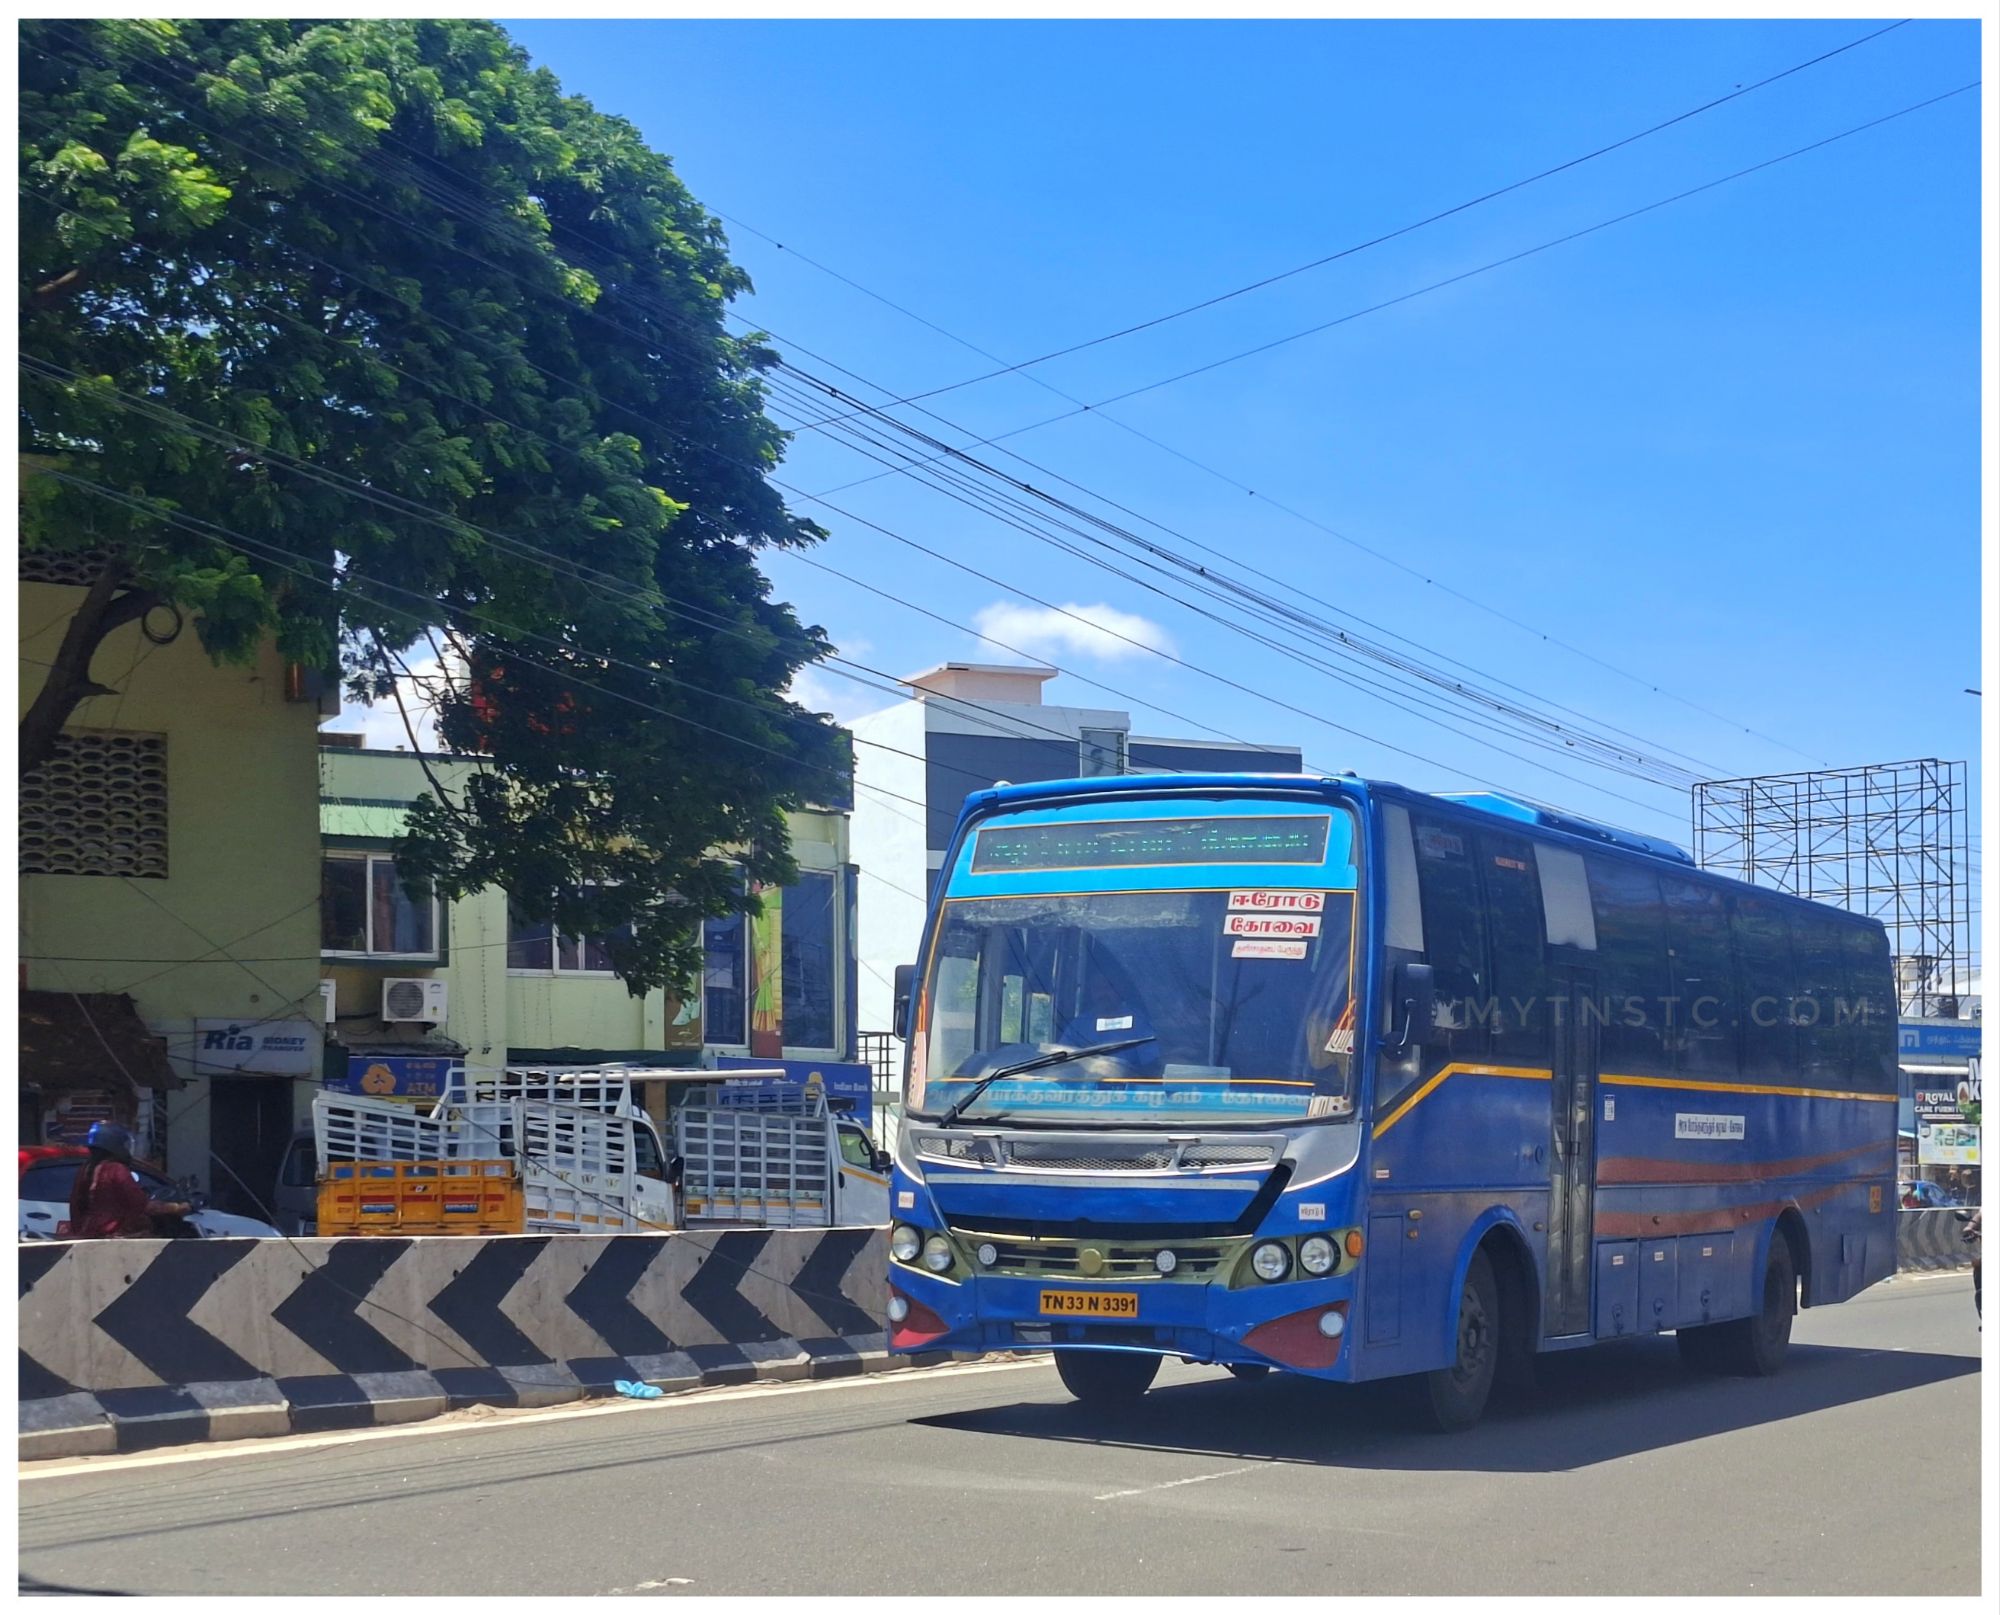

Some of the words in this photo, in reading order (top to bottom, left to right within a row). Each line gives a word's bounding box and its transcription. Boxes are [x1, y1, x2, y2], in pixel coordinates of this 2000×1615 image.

[1233, 892, 1320, 909] ஈரோடு
[1231, 917, 1314, 934] கோவை
[204, 1024, 254, 1050] Ria
[263, 1036, 306, 1045] MONEY
[407, 1082, 437, 1094] ATM
[834, 1082, 852, 1091] Indian
[853, 1083, 868, 1092] Bank
[1925, 1092, 1955, 1104] ROYAL
[1043, 1295, 1064, 1310] TN
[1066, 1296, 1084, 1310] 33
[1088, 1297, 1099, 1311] N
[1103, 1298, 1136, 1312] 3391
